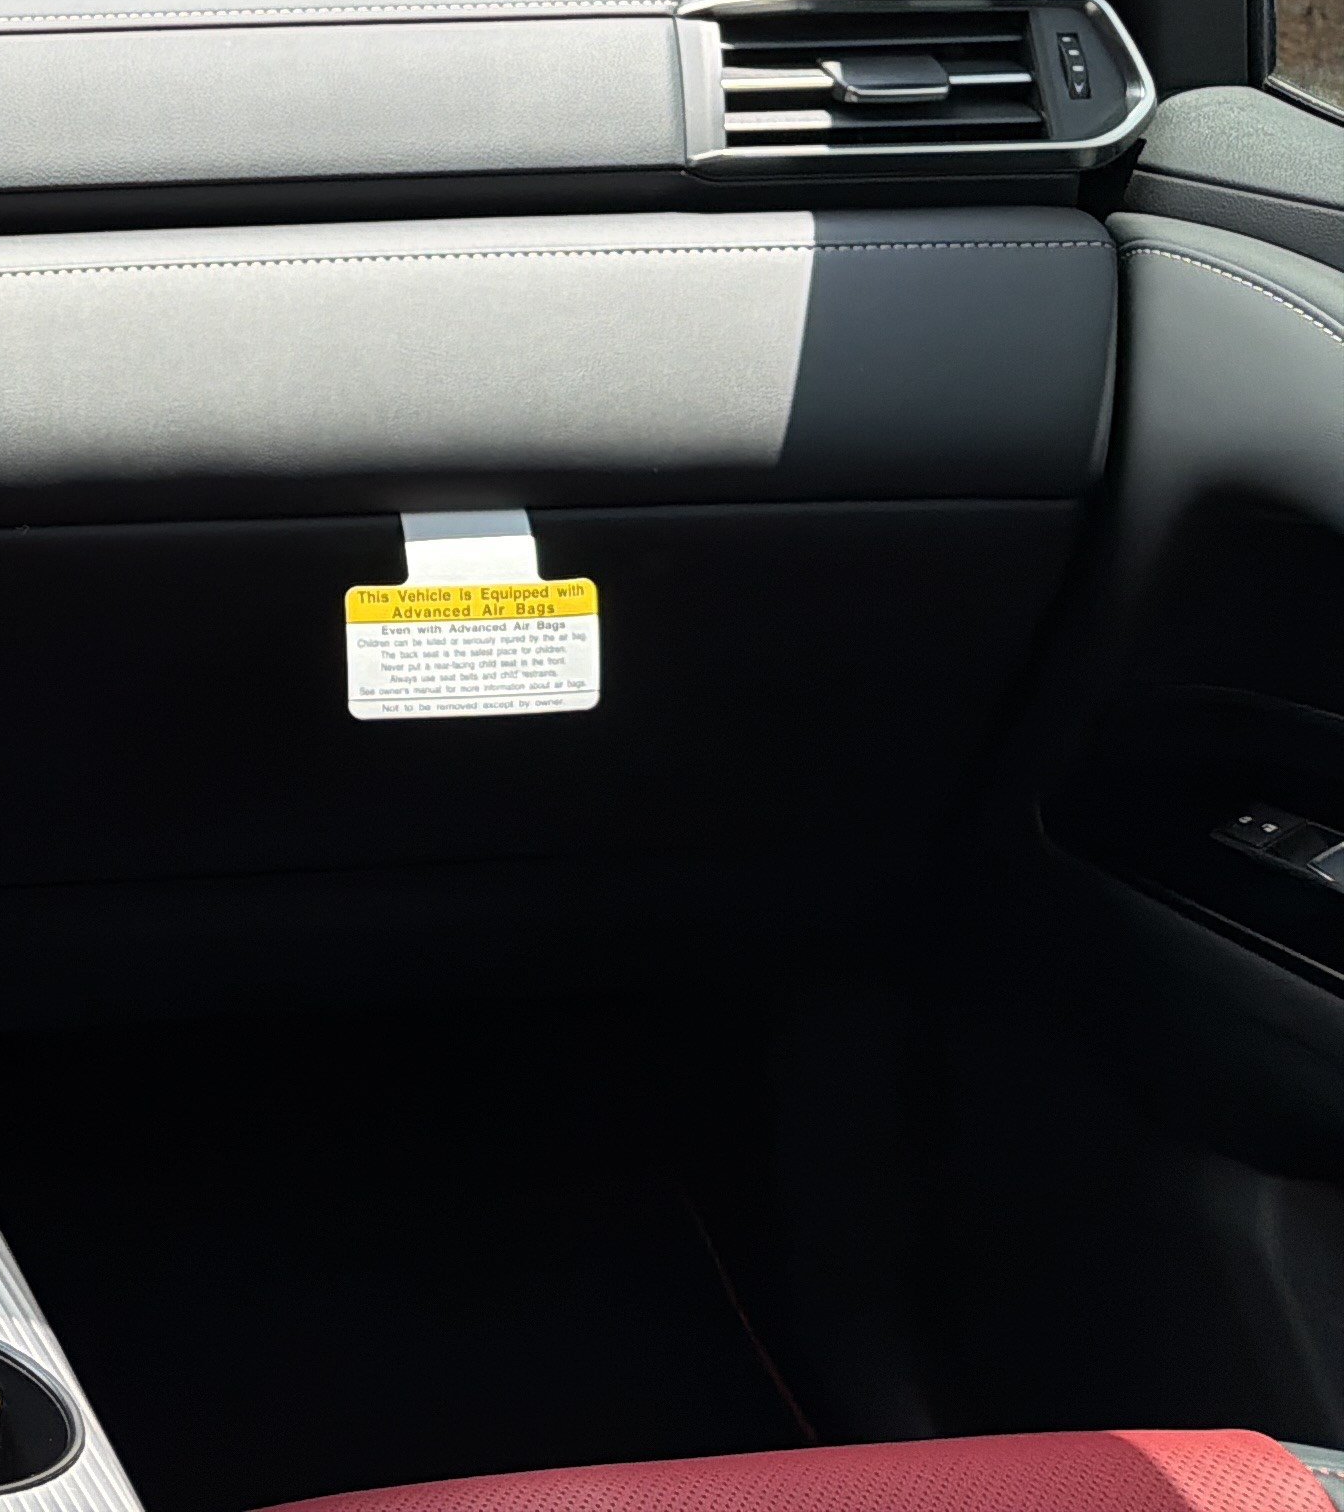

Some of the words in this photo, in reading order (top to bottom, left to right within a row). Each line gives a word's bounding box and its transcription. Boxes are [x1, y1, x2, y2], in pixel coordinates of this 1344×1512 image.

[357, 591, 389, 604] This
[397, 588, 451, 603] Vehicle
[480, 586, 549, 602] Equipped
[557, 584, 584, 598] with
[391, 605, 471, 619] Advanced
[482, 603, 505, 616] Air
[515, 603, 555, 616] Bags
[381, 626, 411, 635] Even
[417, 625, 442, 634] with
[449, 623, 506, 634] Advanced
[513, 621, 530, 631] Air
[537, 621, 566, 632] Bags
[382, 703, 400, 712] Not
[404, 703, 413, 712] to
[418, 703, 431, 711] be
[437, 701, 477, 710] removed
[483, 700, 514, 710] except
[519, 699, 530, 709] by
